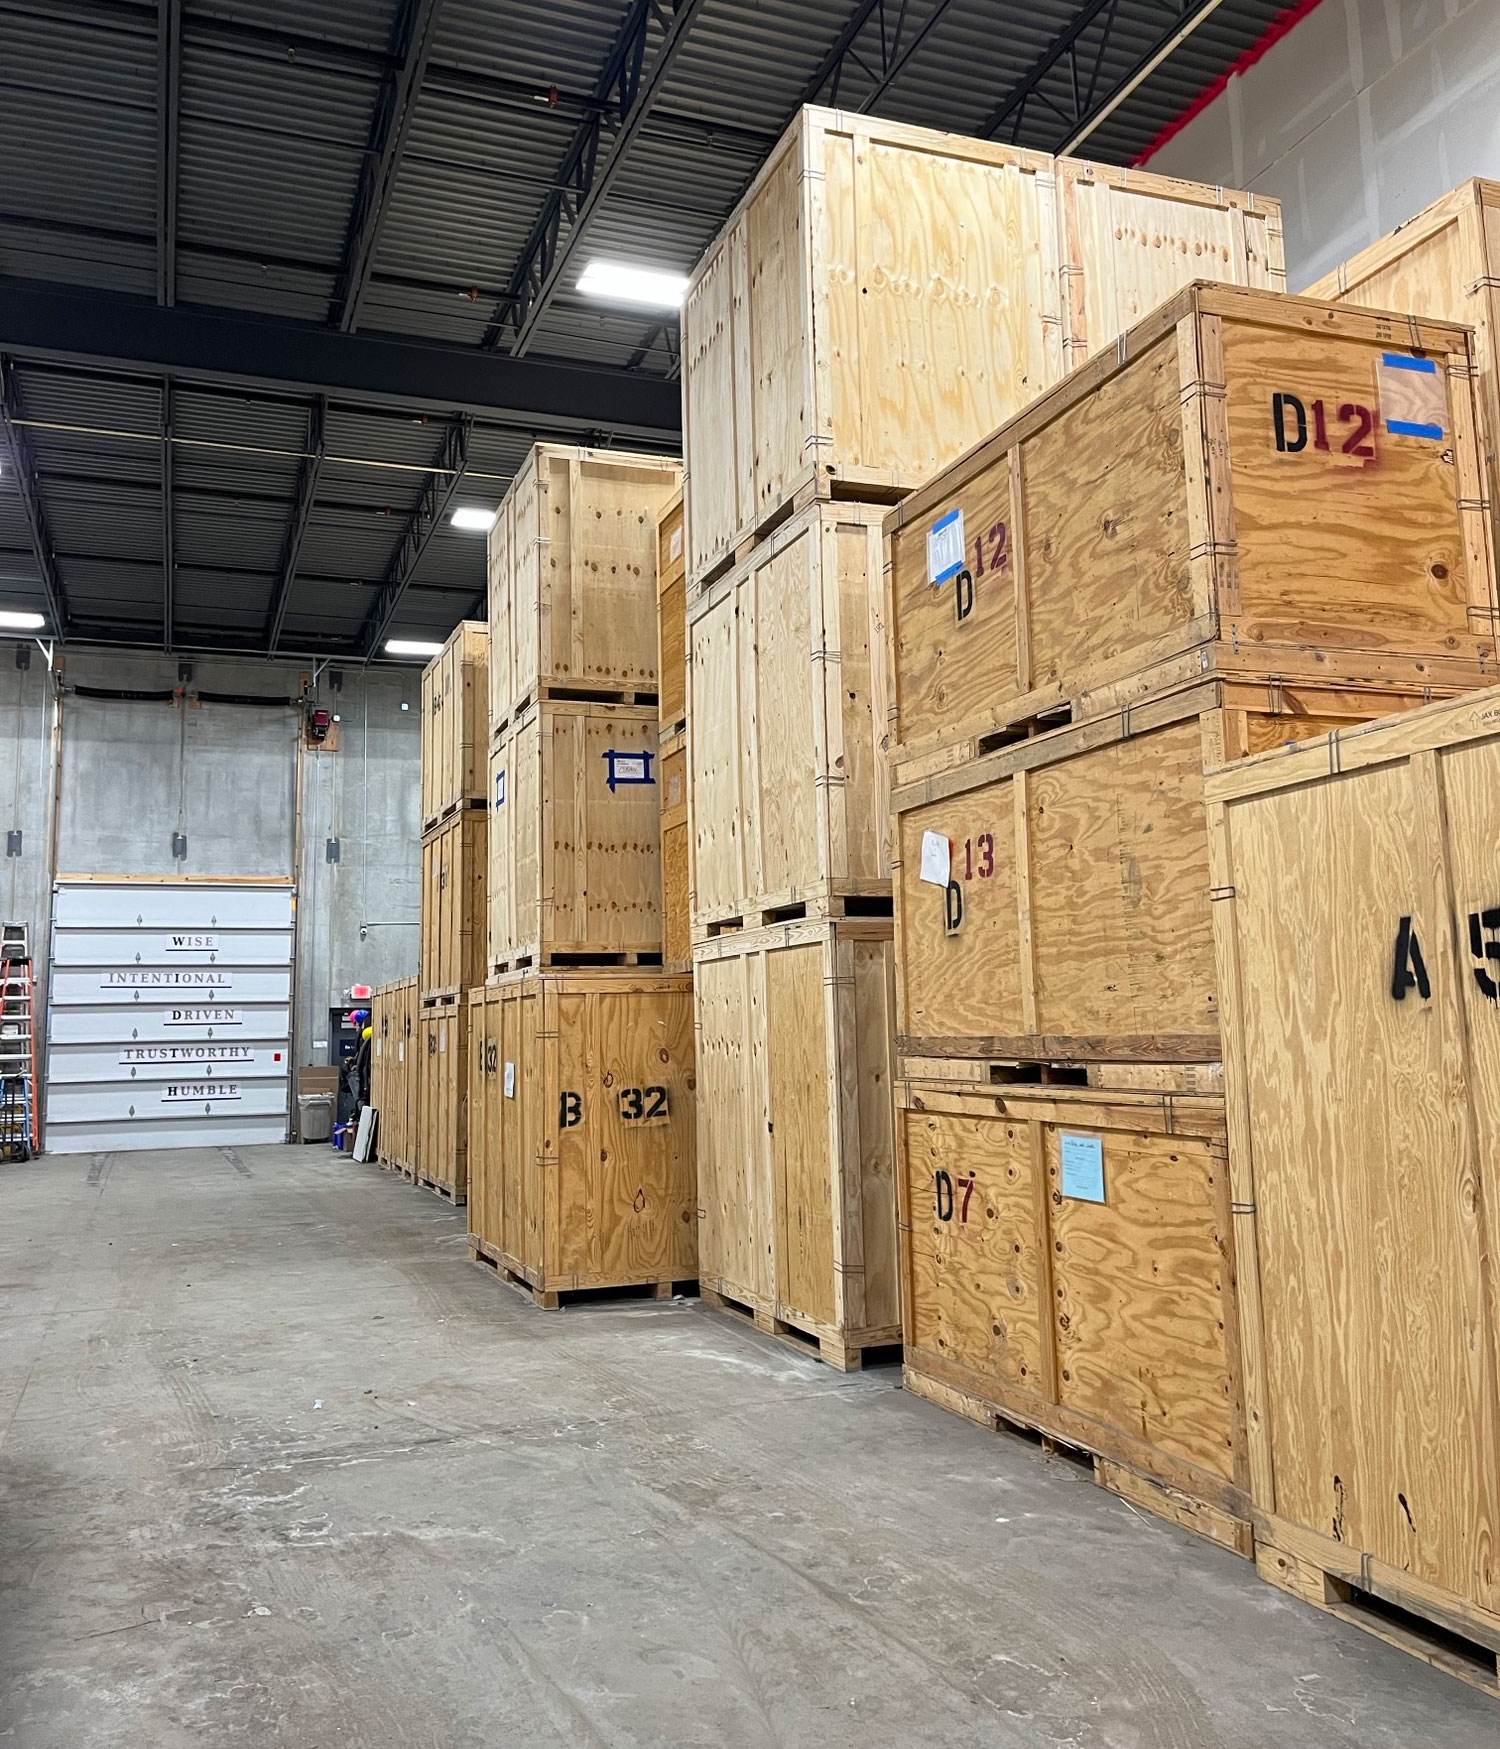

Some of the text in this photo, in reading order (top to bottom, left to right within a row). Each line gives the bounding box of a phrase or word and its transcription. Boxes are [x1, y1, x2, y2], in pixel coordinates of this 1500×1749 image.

[173, 937, 214, 946] WISE
[1392, 916, 1431, 1001] A
[109, 973, 225, 983] INTENTIONAL
[172, 1009, 234, 1020] DRIVEN
[124, 1046, 251, 1059] TRUSTWORTHY
[167, 1084, 237, 1096] HUMBLE
[560, 1086, 667, 1128] B 32
